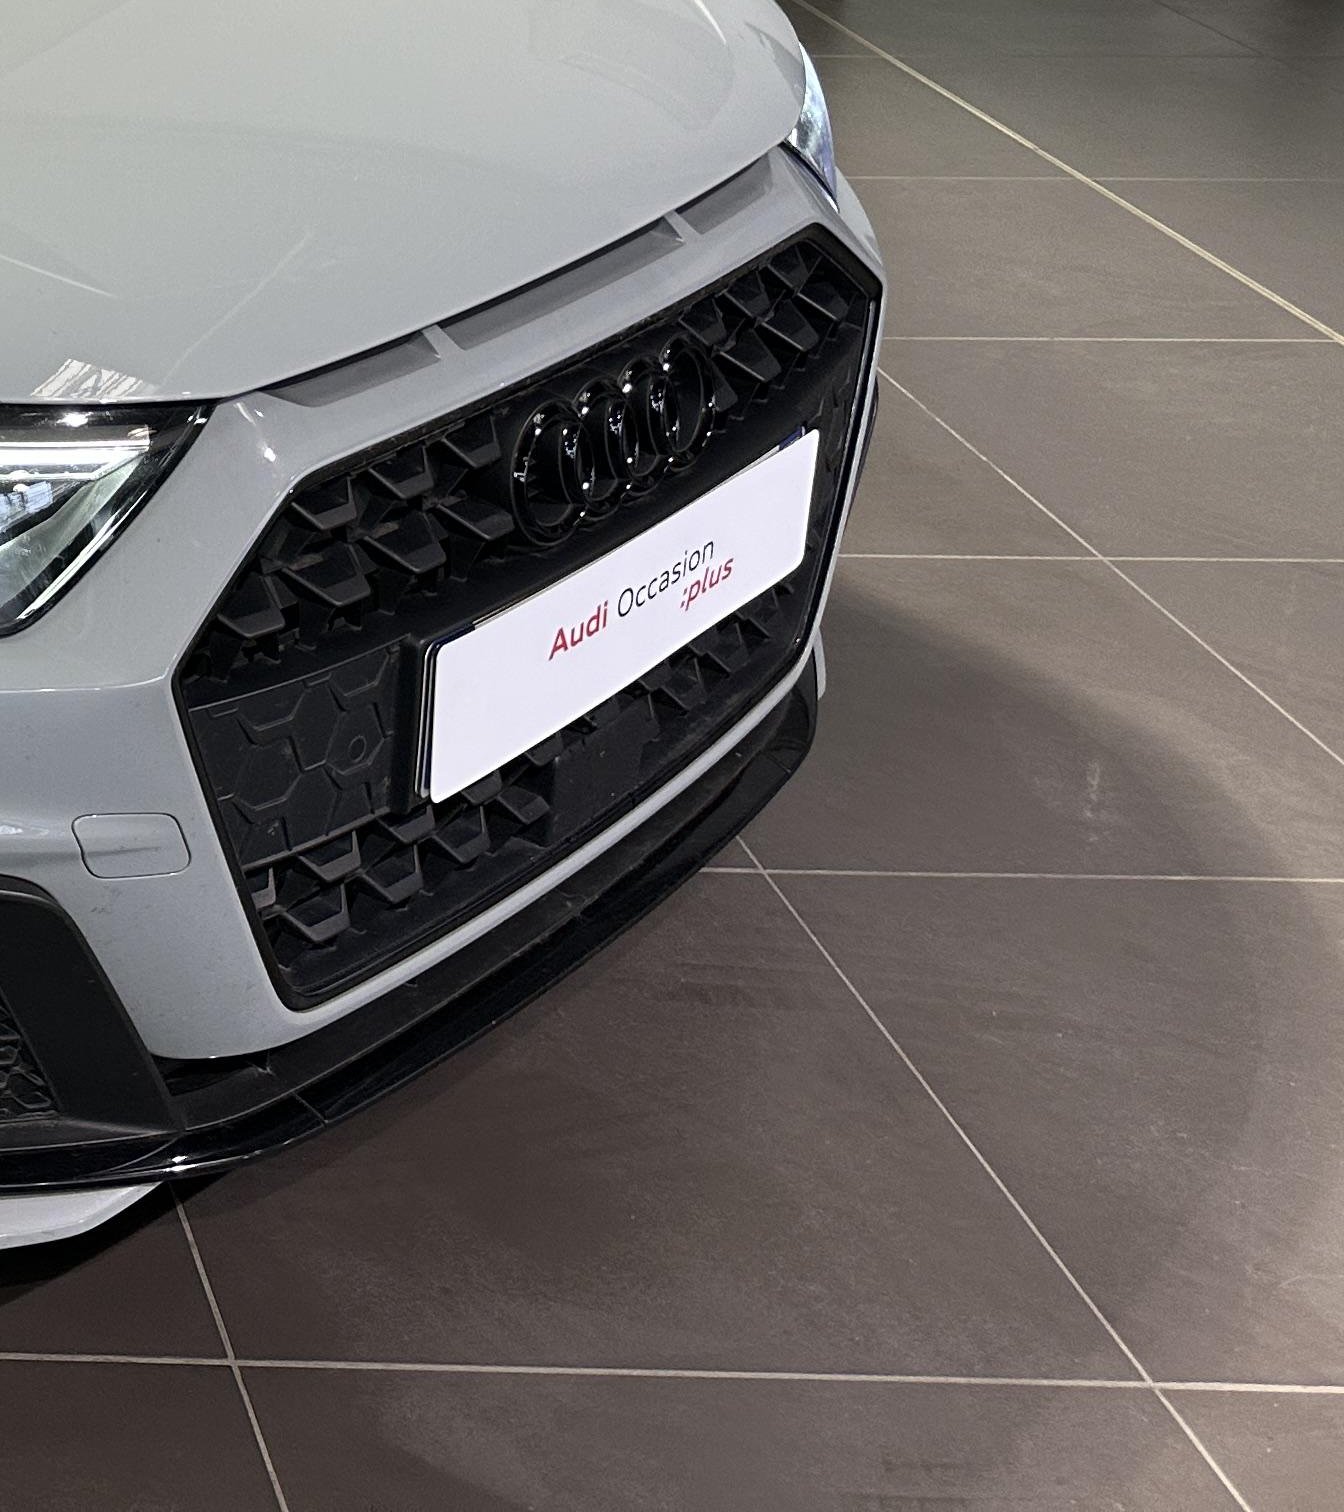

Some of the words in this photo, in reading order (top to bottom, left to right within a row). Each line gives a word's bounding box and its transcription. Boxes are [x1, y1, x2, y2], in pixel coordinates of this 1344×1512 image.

[548, 599, 609, 662] Audi
[617, 540, 715, 618] Occasion
[679, 557, 735, 612] :plus
